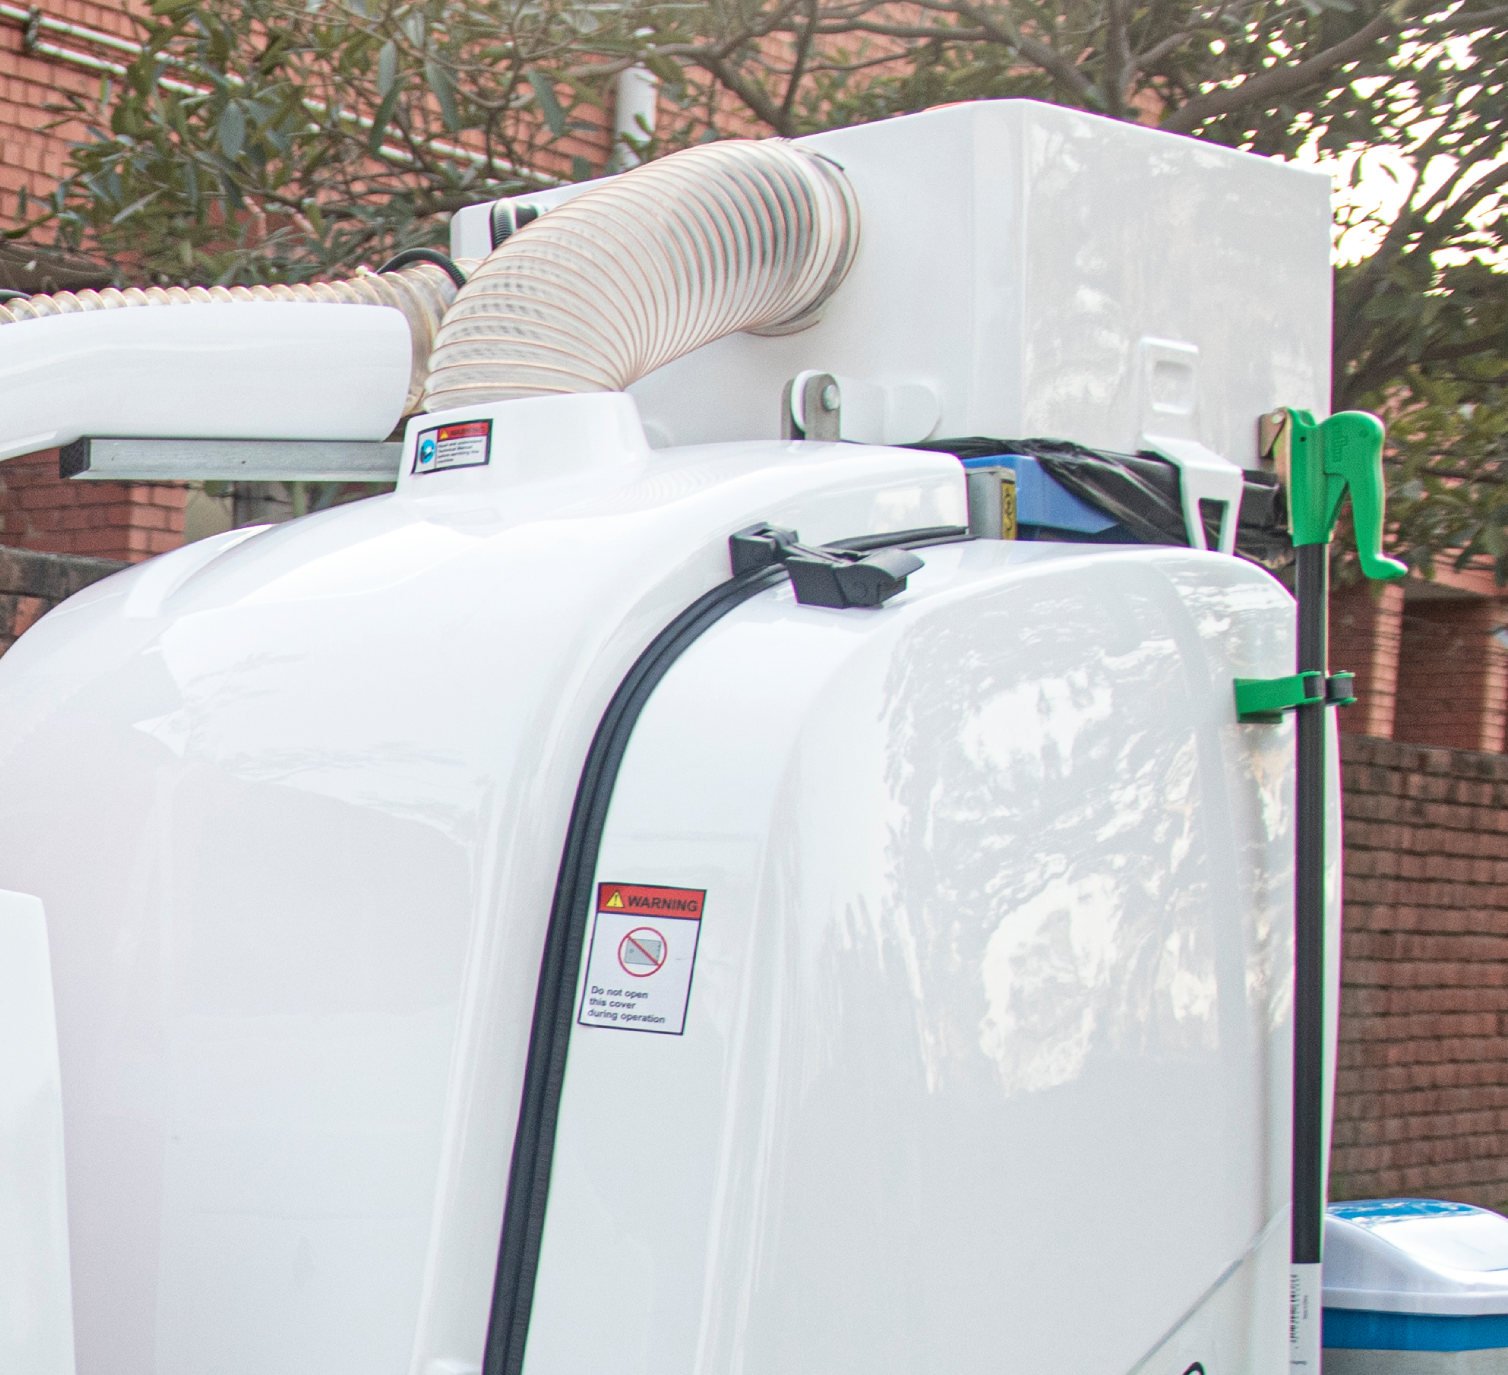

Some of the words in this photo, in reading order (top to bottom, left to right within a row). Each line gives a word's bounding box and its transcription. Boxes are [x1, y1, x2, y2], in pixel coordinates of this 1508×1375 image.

[627, 895, 698, 913] WARNING
[591, 985, 604, 995] Do
[606, 988, 623, 997] not
[624, 990, 648, 999] open
[589, 998, 607, 1007] this
[609, 1000, 636, 1009] cover
[587, 1009, 618, 1021] during
[620, 1012, 666, 1024] operation
